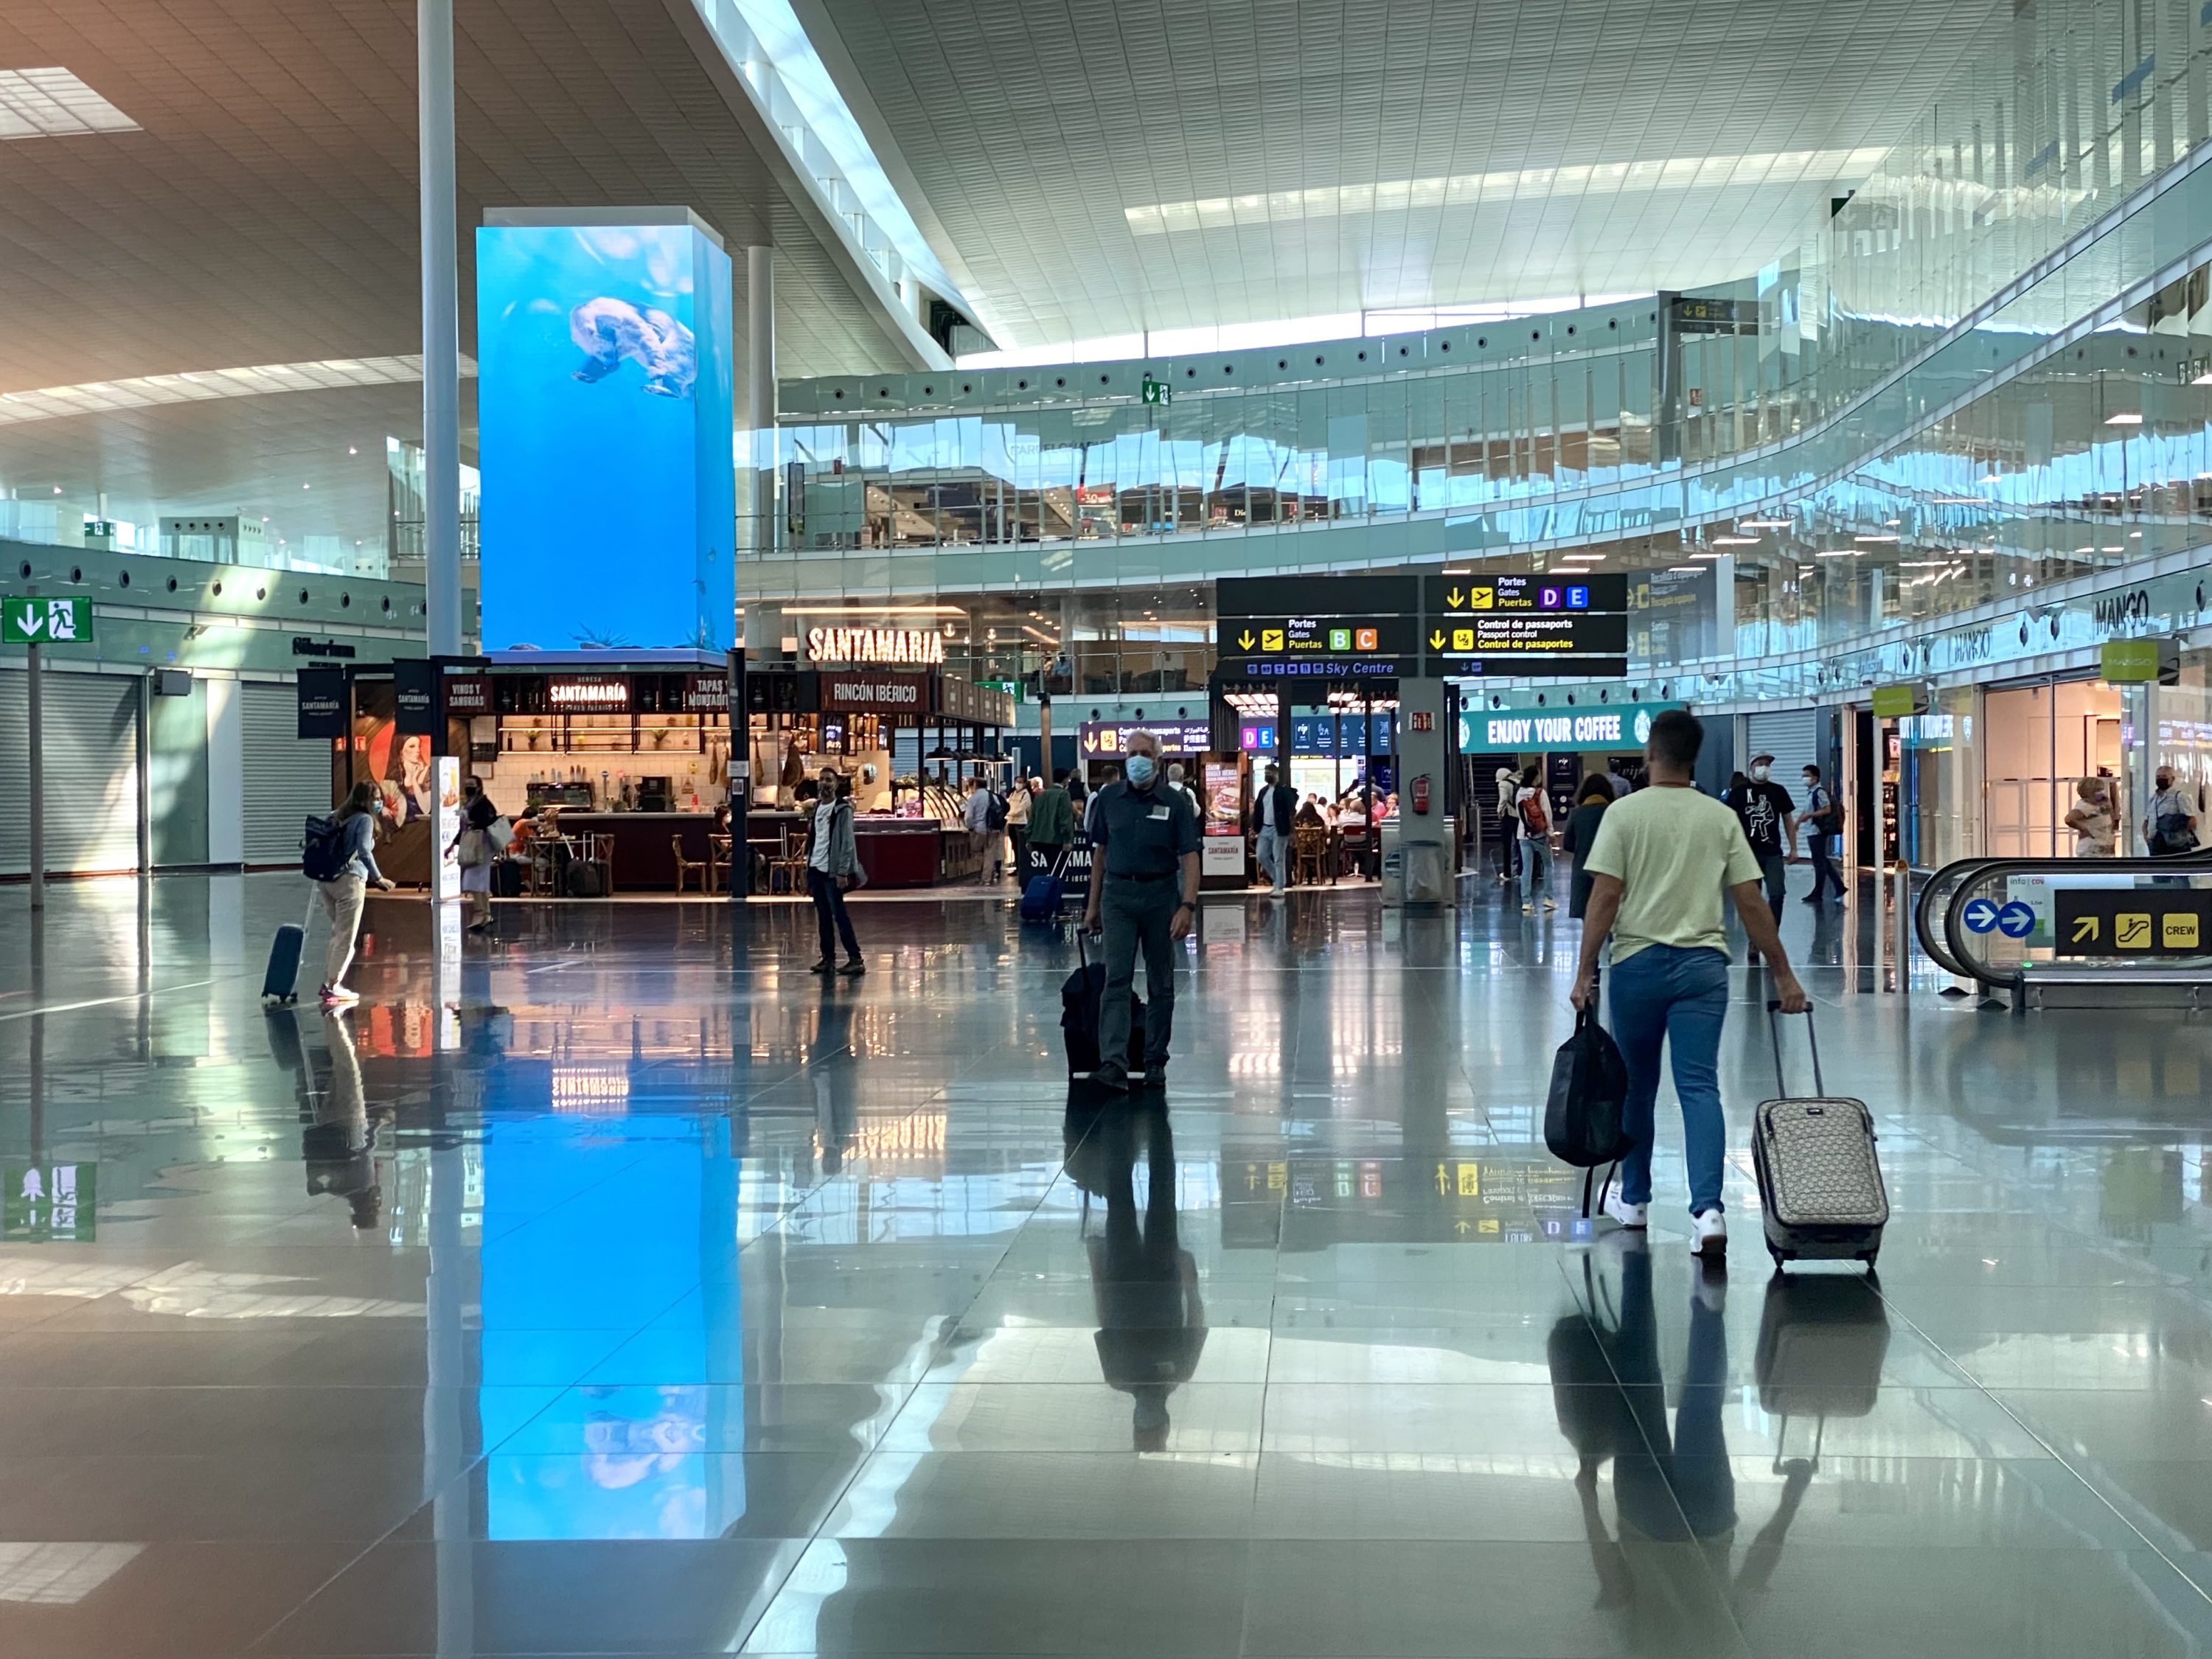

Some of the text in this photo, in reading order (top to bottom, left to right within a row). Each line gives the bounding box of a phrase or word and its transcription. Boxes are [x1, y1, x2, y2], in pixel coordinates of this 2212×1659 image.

[1498, 577, 1526, 586] Portes
[1498, 588, 1520, 597] Gates
[1544, 589, 1582, 605] D E
[1498, 598, 1532, 607] Puertas
[2096, 590, 2149, 636] MANGO
[1288, 619, 1317, 628] Portes
[1478, 620, 1573, 630] Control de passaports
[1288, 630, 1310, 639] Gates
[1333, 631, 1372, 647] B C
[1478, 630, 1537, 639] Passport control
[807, 627, 943, 664] SANTAMARIA
[1289, 640, 1322, 649] Puertas
[1478, 640, 1573, 650] Control de pasaportes
[1326, 663, 1394, 676] Sky Centre
[474, 684, 481, 693] Y
[697, 680, 723, 692] TAPAS
[550, 682, 627, 702] SANTAMARÍA
[834, 681, 917, 703] RINCÓN IBÉRICO
[1488, 714, 1621, 744] ENJOY YOUR COFFEE
[1245, 731, 1269, 744] D E
[2166, 926, 2196, 935] CREW
